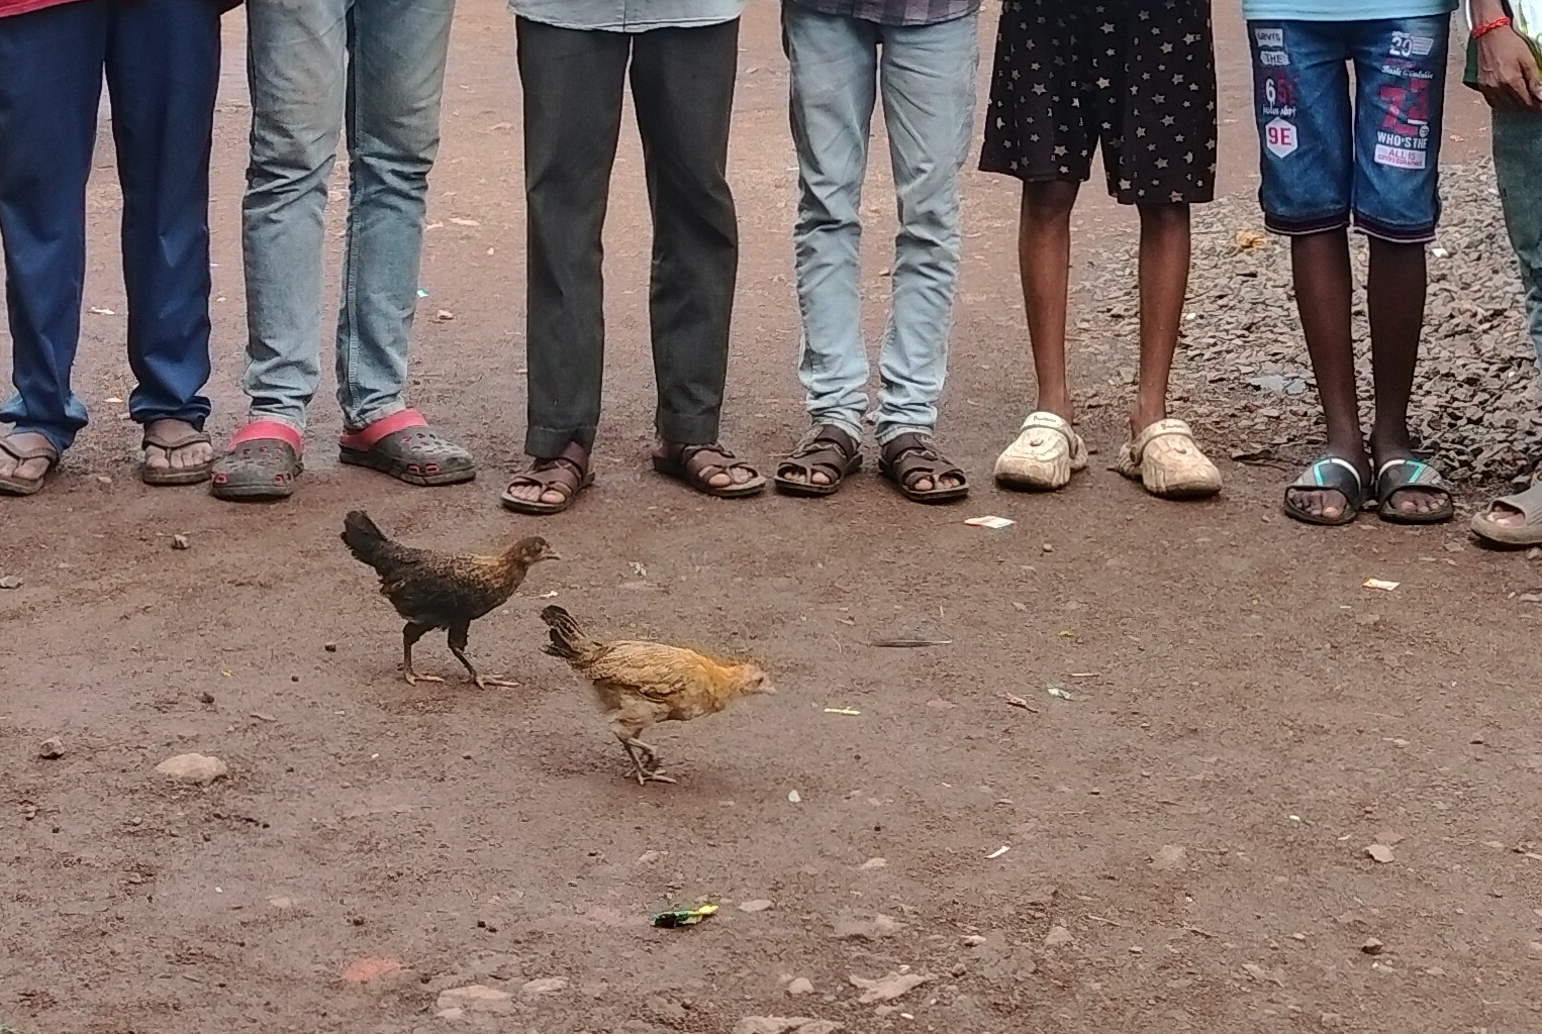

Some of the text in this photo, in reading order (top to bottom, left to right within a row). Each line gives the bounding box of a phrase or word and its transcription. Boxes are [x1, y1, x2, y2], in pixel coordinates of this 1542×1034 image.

[1265, 54, 1283, 63] THE
[1268, 127, 1292, 145] 9E
[1377, 131, 1412, 148] WHO'S
[1413, 138, 1428, 149] THE
[1389, 149, 1406, 159] ALL
